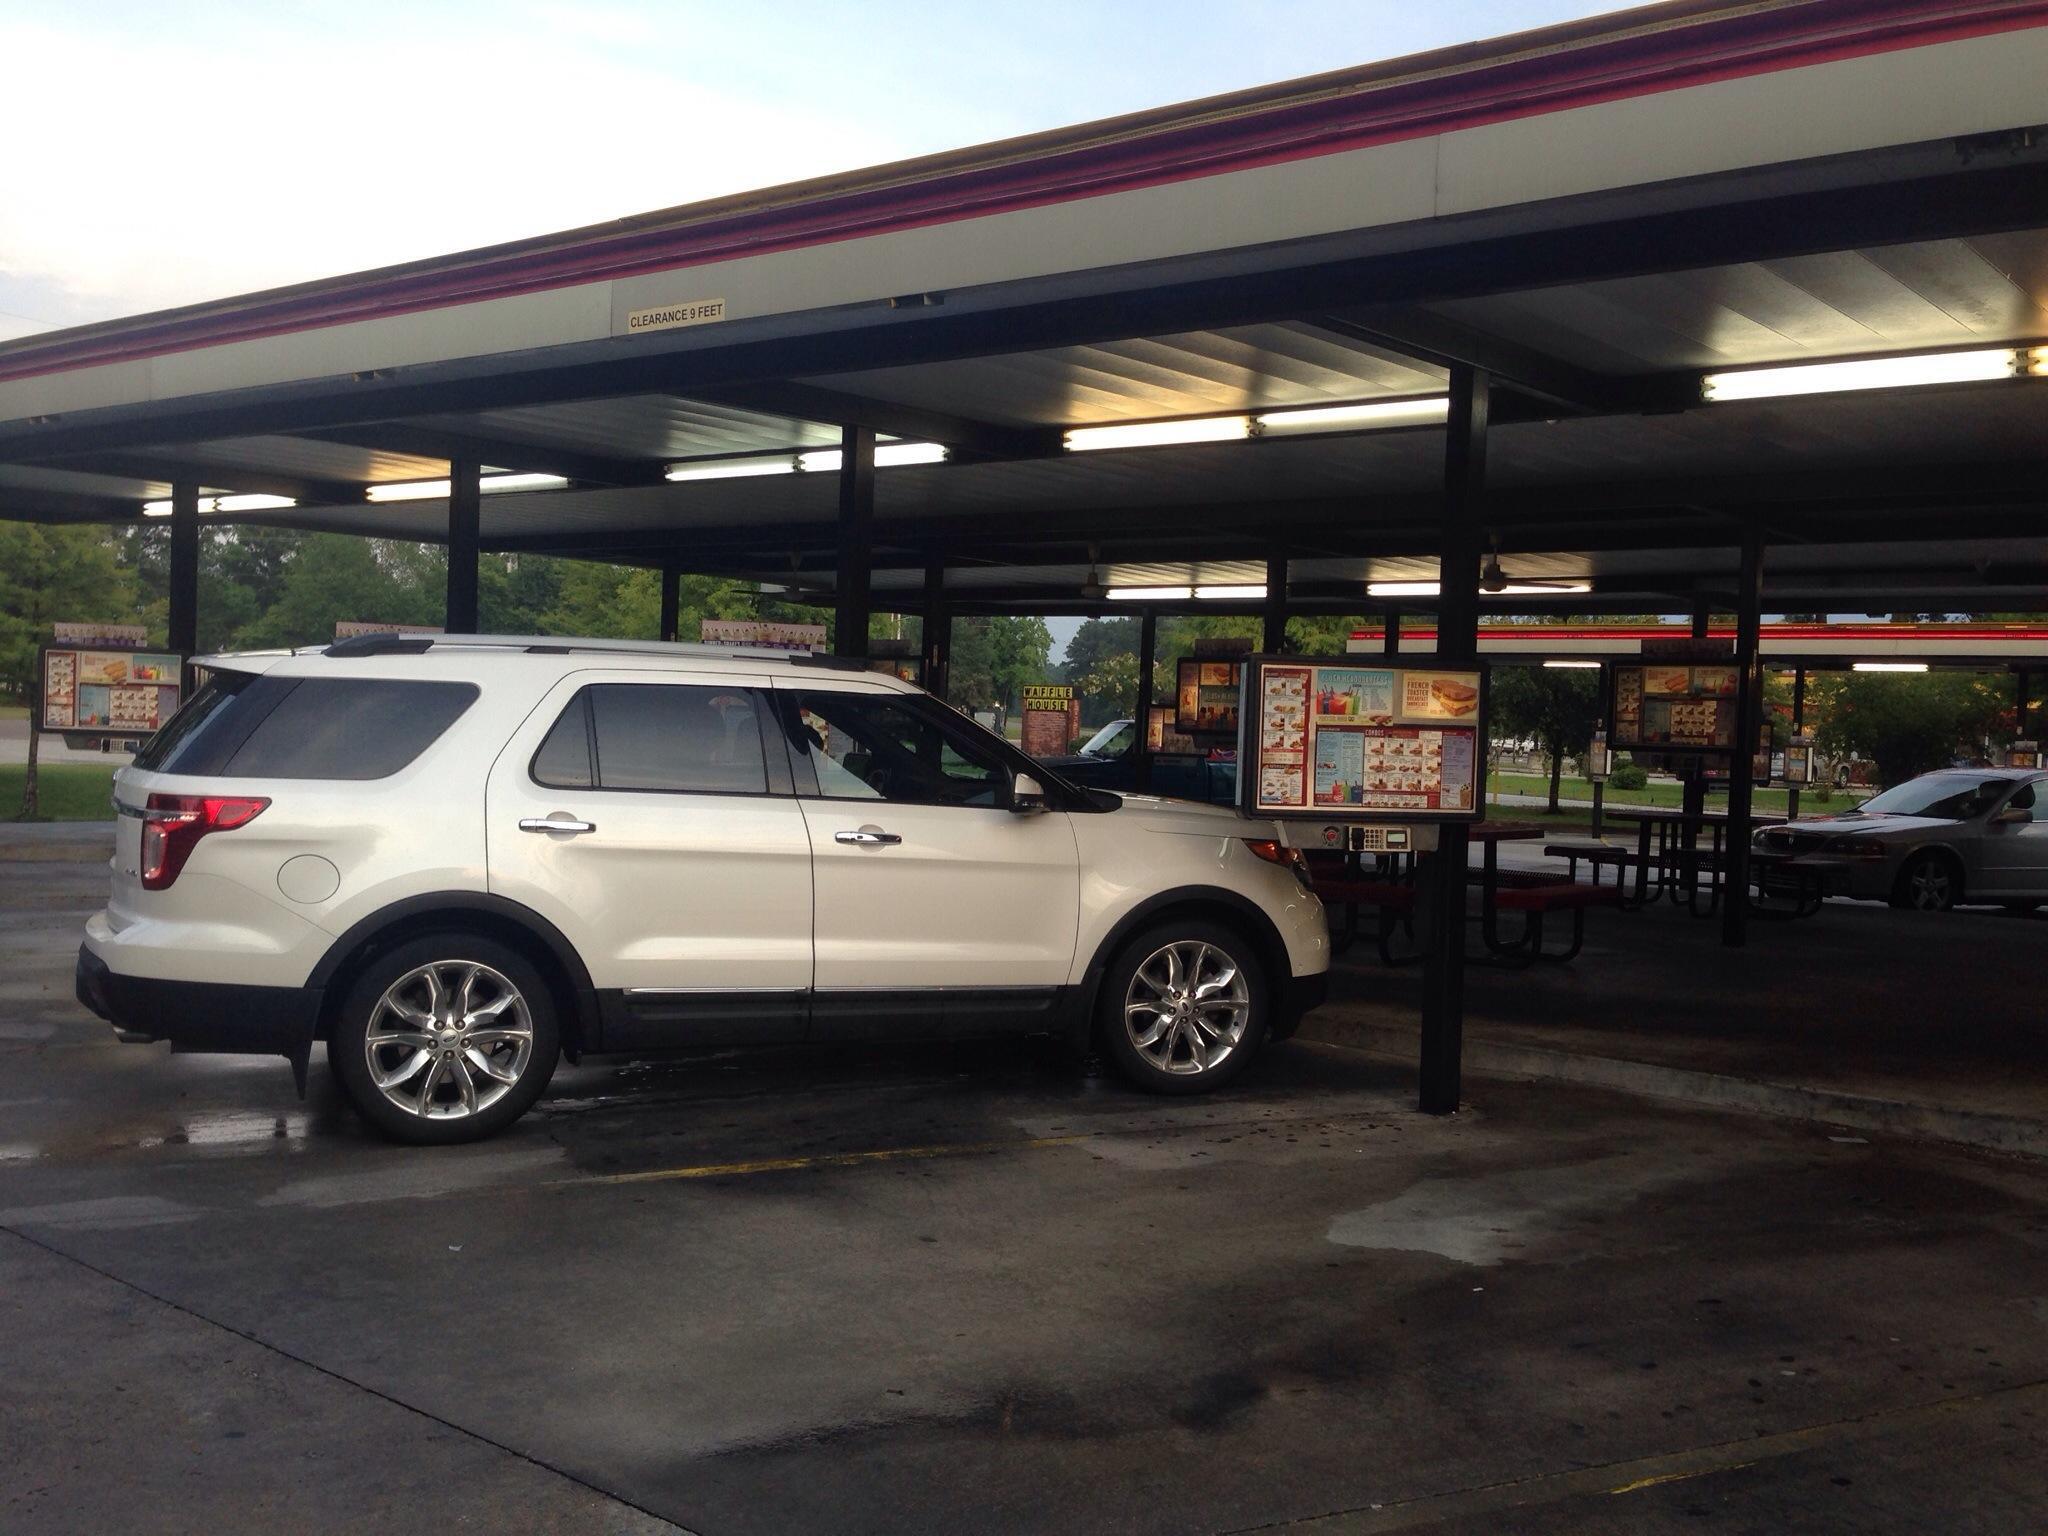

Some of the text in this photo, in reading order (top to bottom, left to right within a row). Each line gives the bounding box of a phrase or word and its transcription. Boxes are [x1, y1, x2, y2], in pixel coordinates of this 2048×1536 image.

[630, 304, 723, 328] CLEARANCE 9 FEET
[1025, 687, 1071, 698] WAFFLE
[1028, 700, 1066, 710] HOUSE
